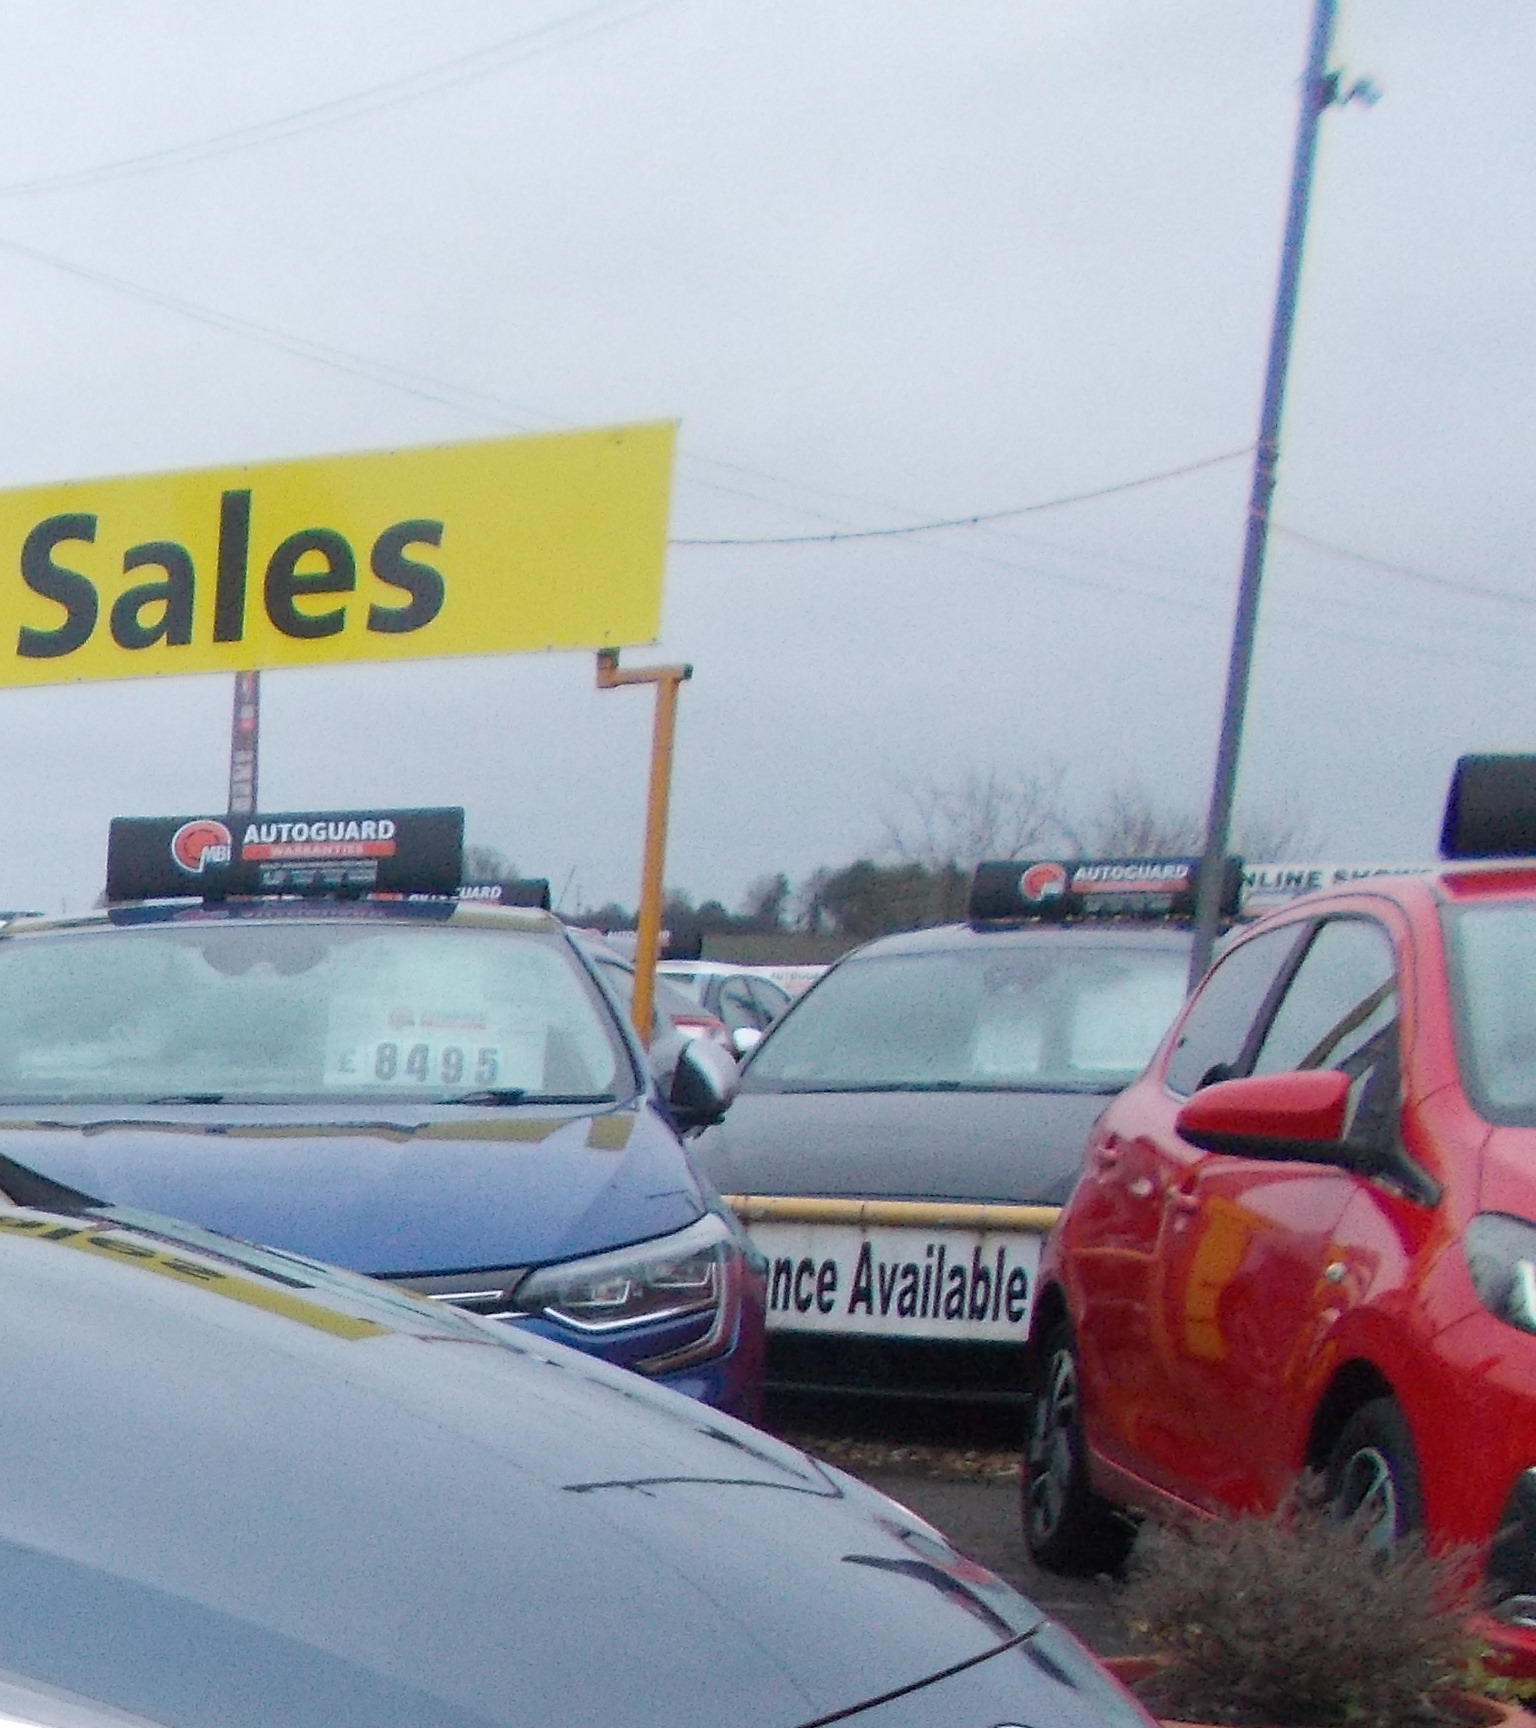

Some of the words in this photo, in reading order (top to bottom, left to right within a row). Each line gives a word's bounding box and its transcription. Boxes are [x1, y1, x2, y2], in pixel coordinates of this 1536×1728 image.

[16, 488, 446, 659] Sales
[243, 820, 395, 844] AUTOGUARD
[1074, 865, 1190, 881] AUTOGUARD
[374, 1042, 500, 1086] 8495
[769, 1256, 839, 1314] nce
[847, 1241, 1028, 1323] Available
